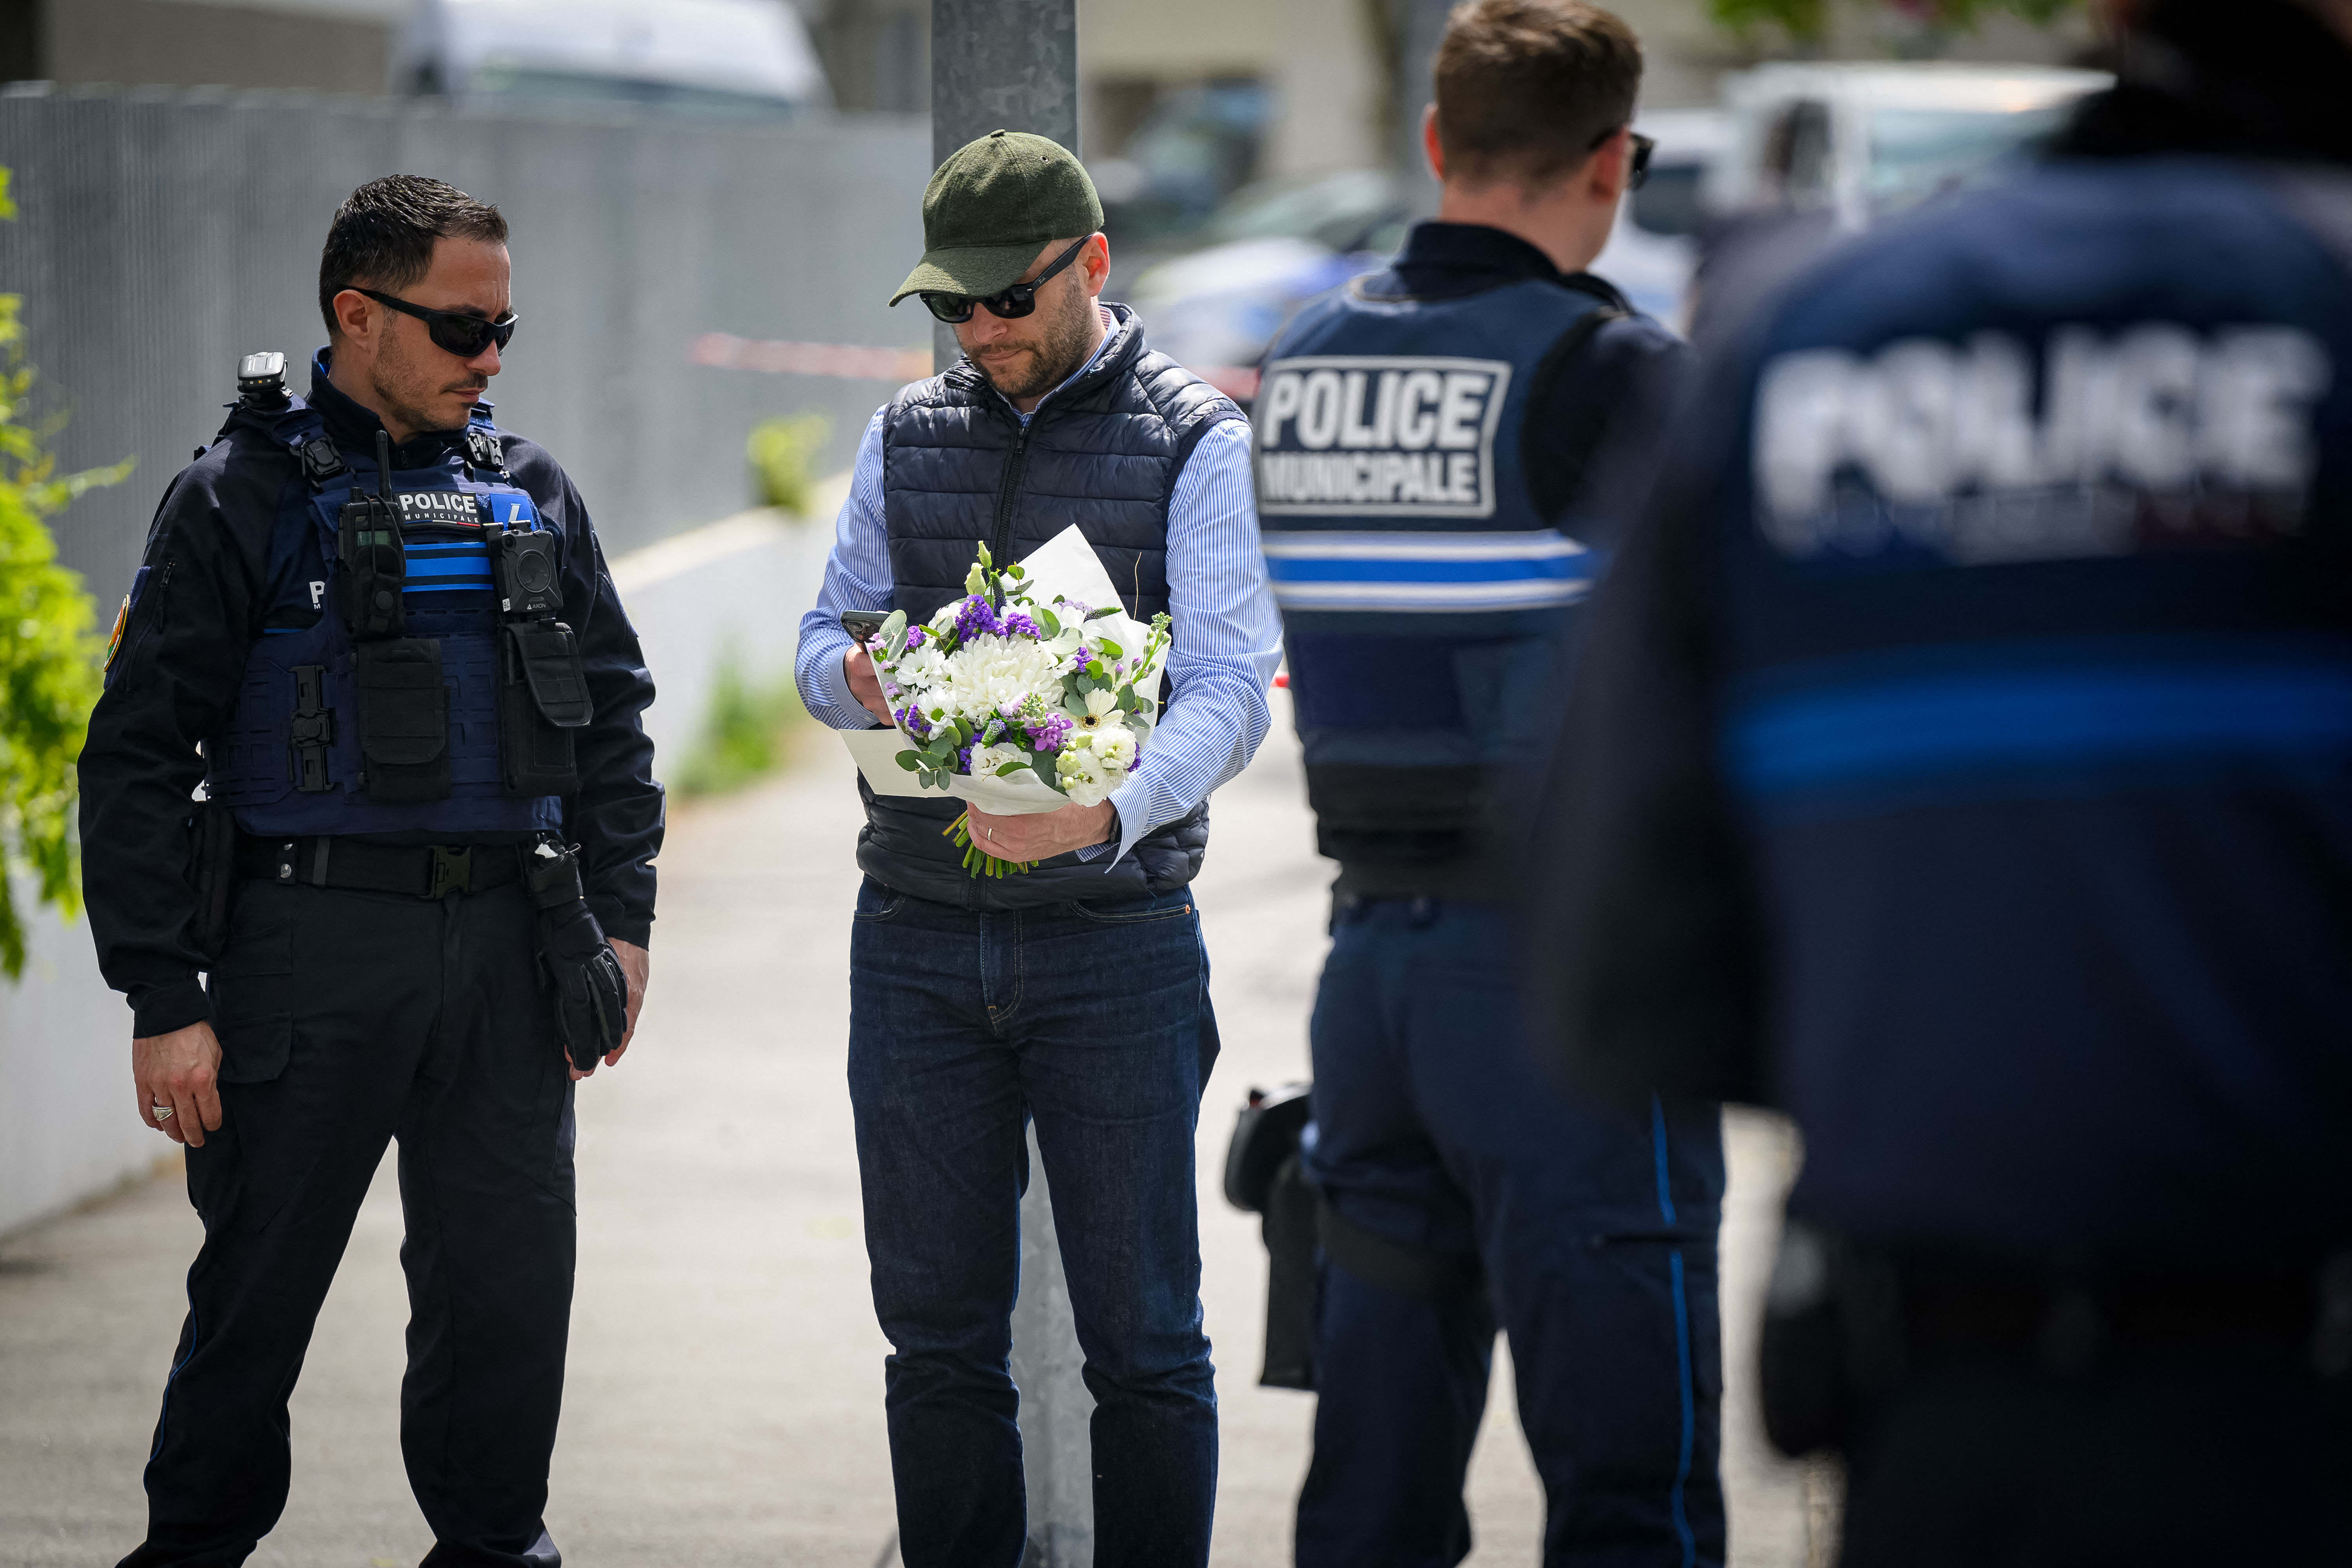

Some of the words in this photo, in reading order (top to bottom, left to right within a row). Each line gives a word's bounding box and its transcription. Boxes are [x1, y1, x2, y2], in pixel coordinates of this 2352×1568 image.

[1262, 369, 1490, 450] POLICE
[1261, 452, 1477, 503] MUNICIPALE
[399, 493, 477, 514] POLICE
[405, 513, 479, 523] MUNICIPALE
